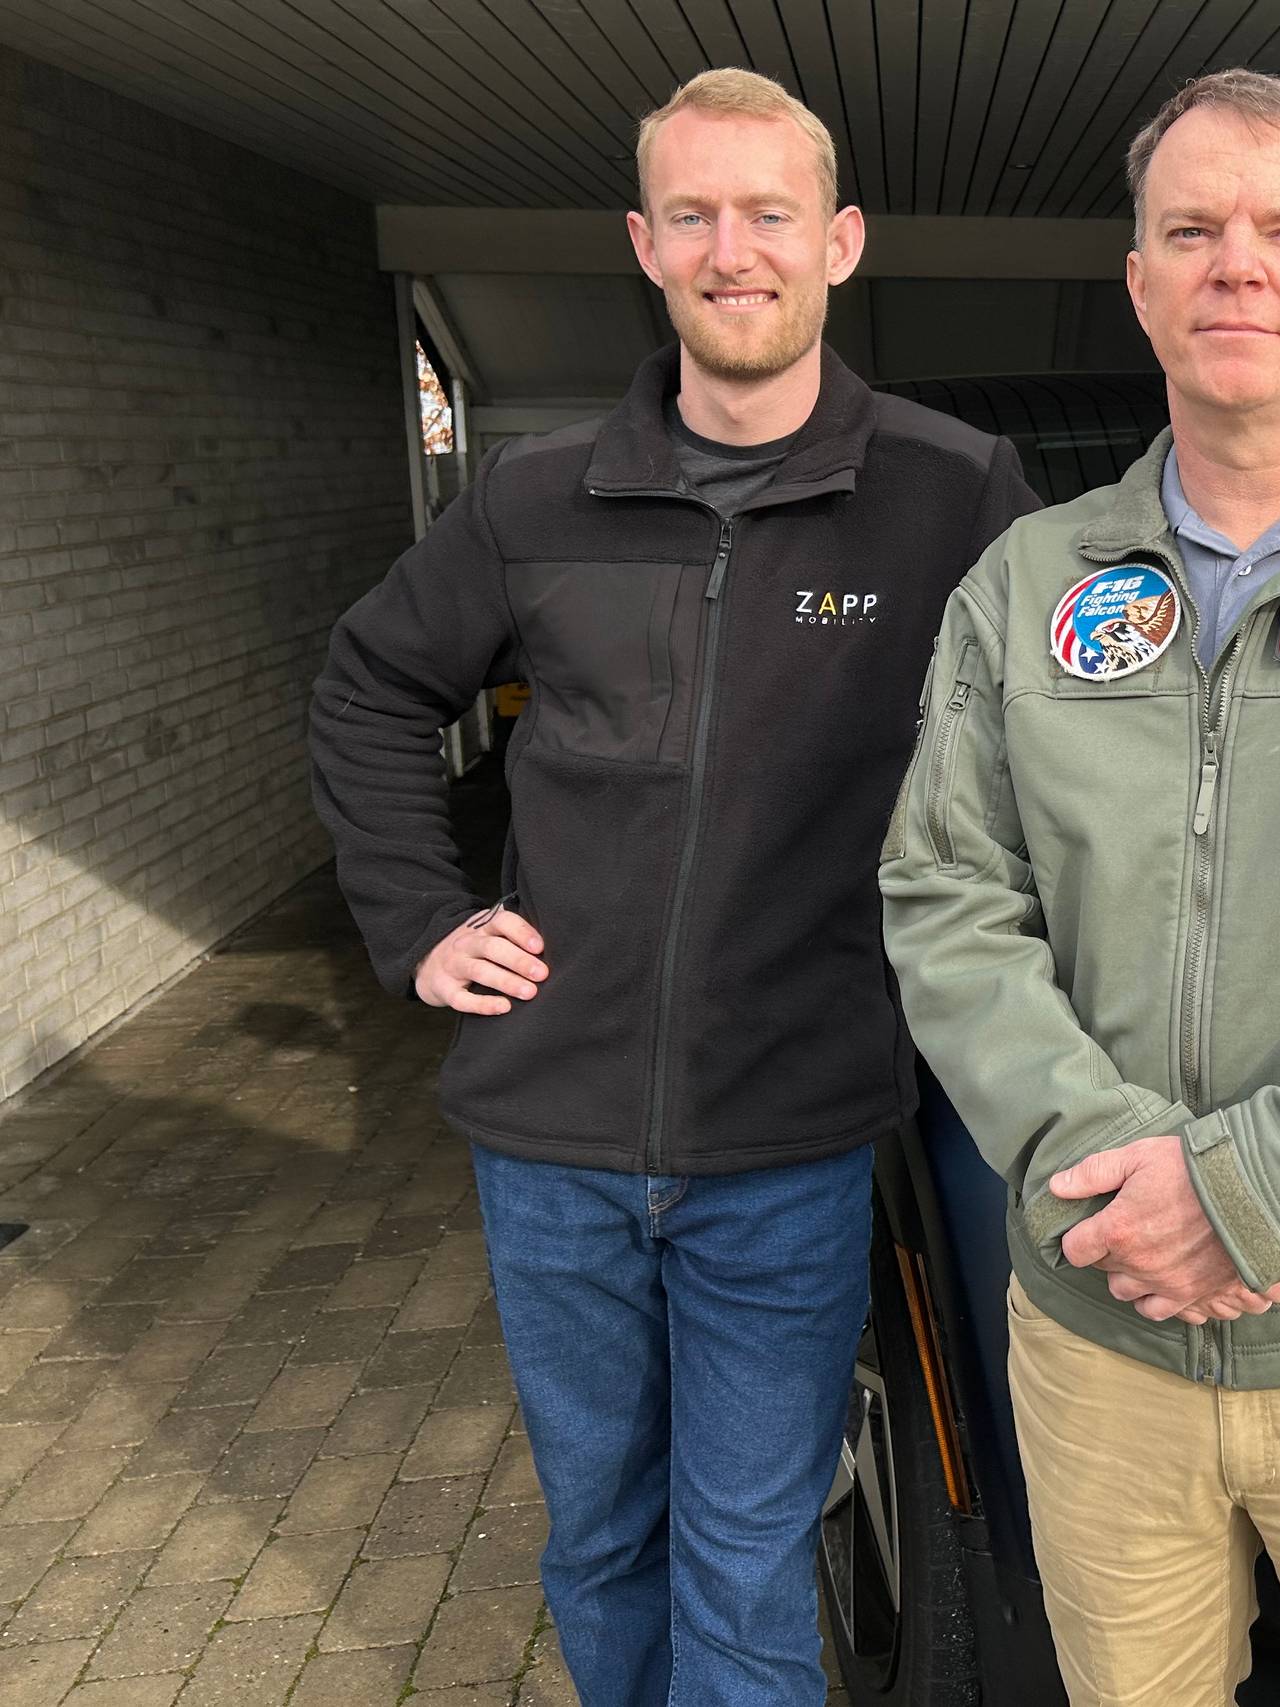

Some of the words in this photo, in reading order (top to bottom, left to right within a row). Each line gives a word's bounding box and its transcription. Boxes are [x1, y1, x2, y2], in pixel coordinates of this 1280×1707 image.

[795, 591, 877, 615] ZAPP
[1080, 591, 1140, 607] Fighting
[1077, 604, 1125, 618] Falcon
